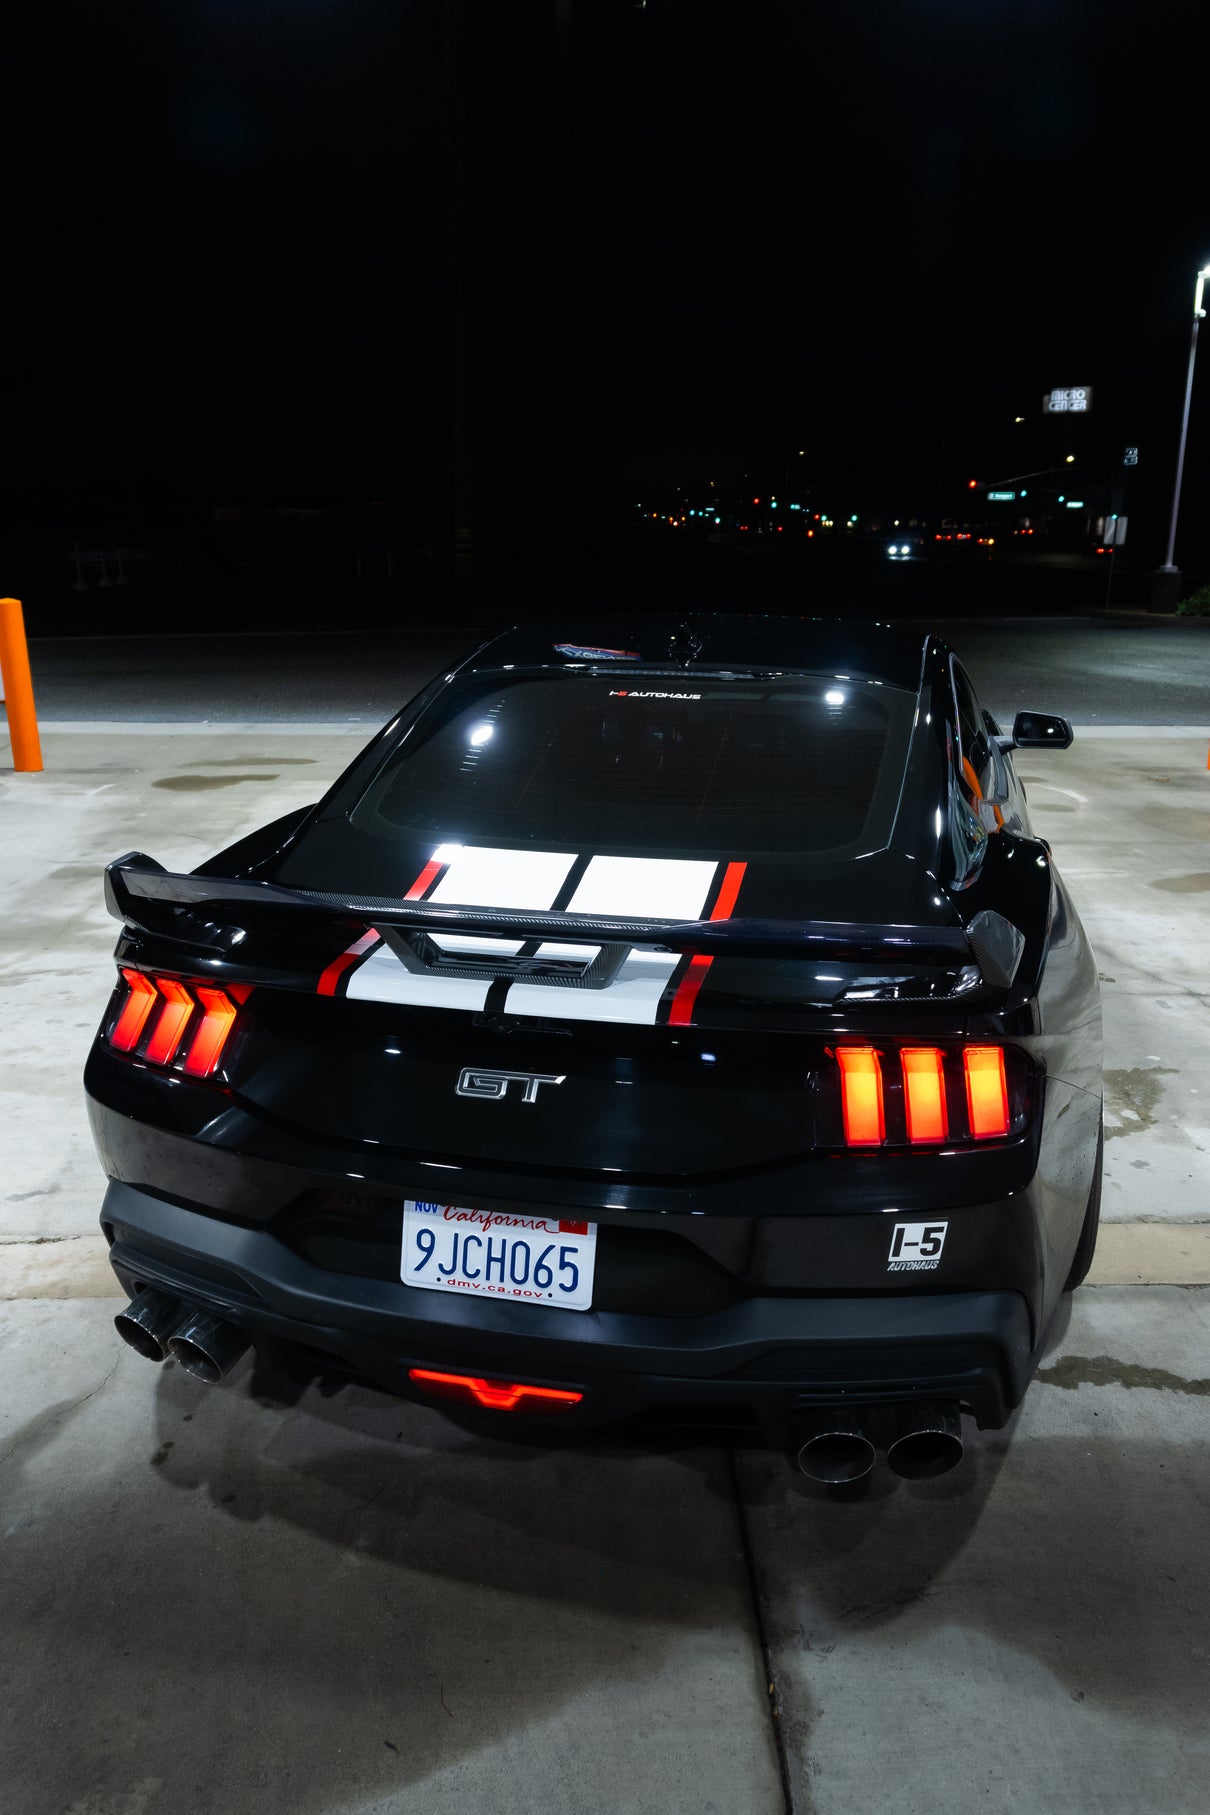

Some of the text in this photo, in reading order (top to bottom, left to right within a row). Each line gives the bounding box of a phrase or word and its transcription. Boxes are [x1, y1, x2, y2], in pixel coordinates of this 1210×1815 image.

[1051, 389, 1086, 400] MICRO
[628, 691, 701, 700] AUTOHAUS
[455, 1067, 566, 1103] GT
[415, 1201, 438, 1214] NOV
[443, 1205, 560, 1234] California
[891, 1226, 945, 1257] I-5
[413, 1228, 579, 1293] 9JCH065
[887, 1260, 940, 1272] AUTOHAUS
[447, 1279, 543, 1298] dmv.ca.gov
